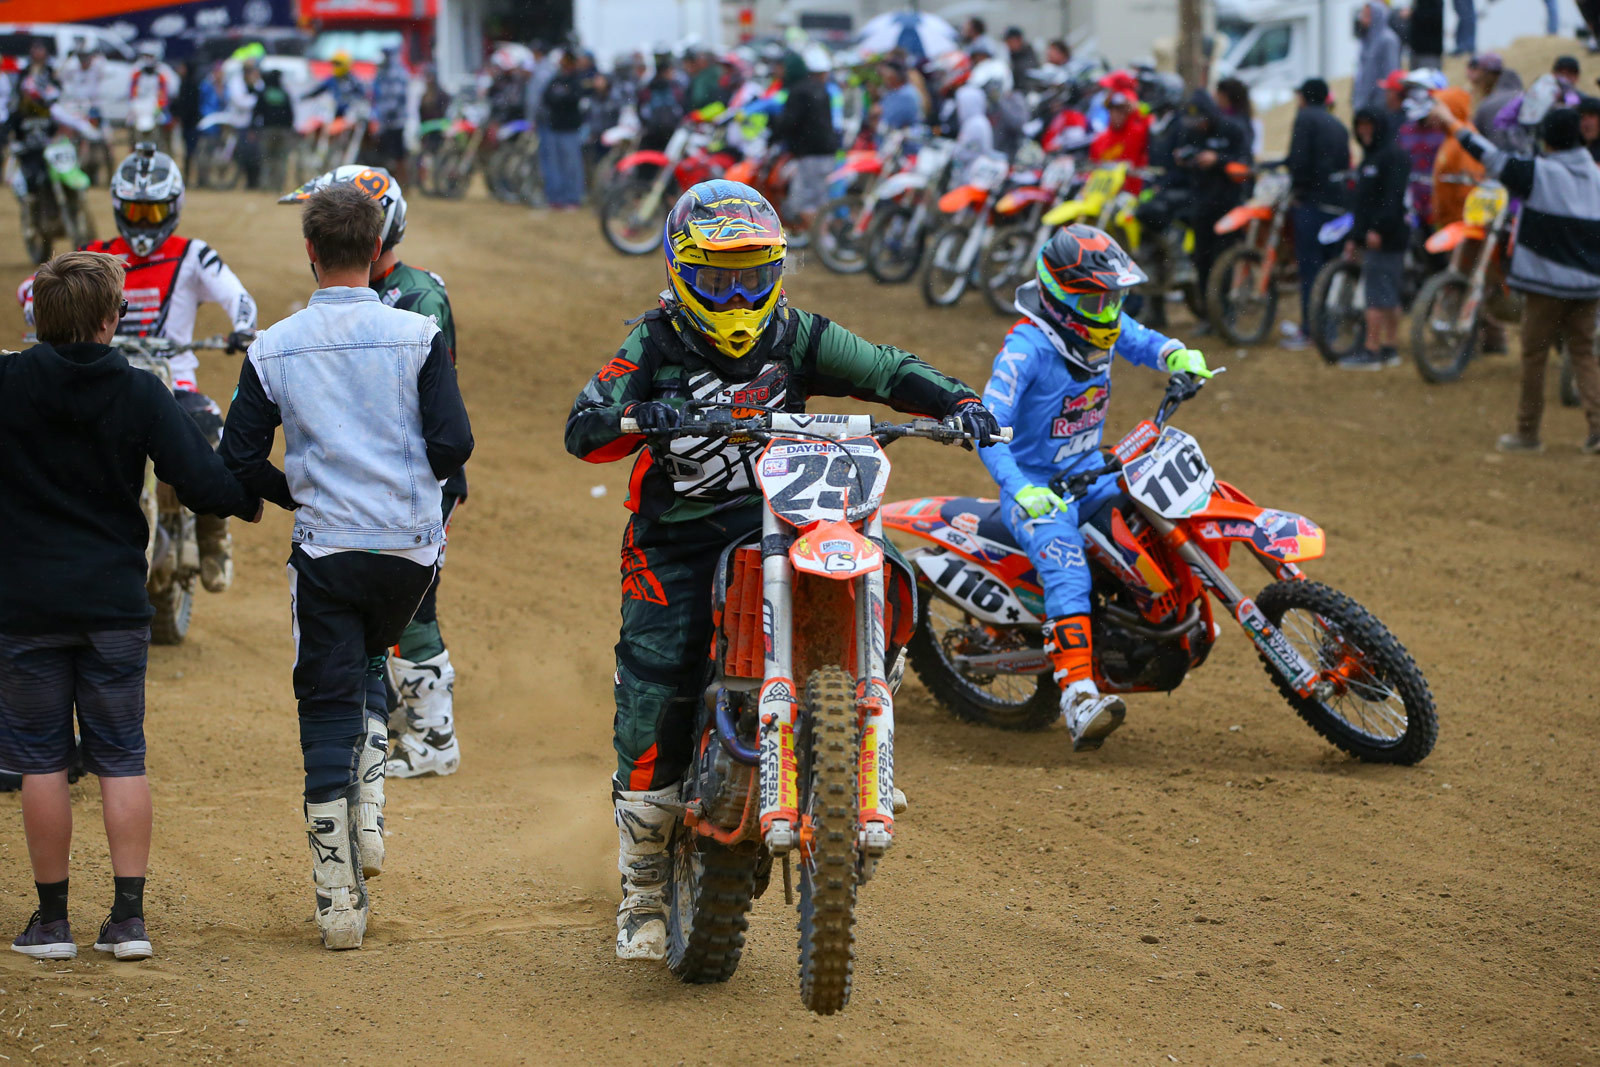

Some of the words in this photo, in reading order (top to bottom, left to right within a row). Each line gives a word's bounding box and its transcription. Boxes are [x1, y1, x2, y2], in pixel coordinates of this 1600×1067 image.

[786, 444, 813, 454] DAY
[1053, 408, 1089, 437] Red
[769, 454, 881, 511] 29
[1141, 444, 1202, 513] 116
[936, 558, 1010, 613] 116
[1250, 620, 1301, 672] DNLOP
[781, 725, 797, 804] PIRELLI
[861, 727, 874, 808] PIRELLI
